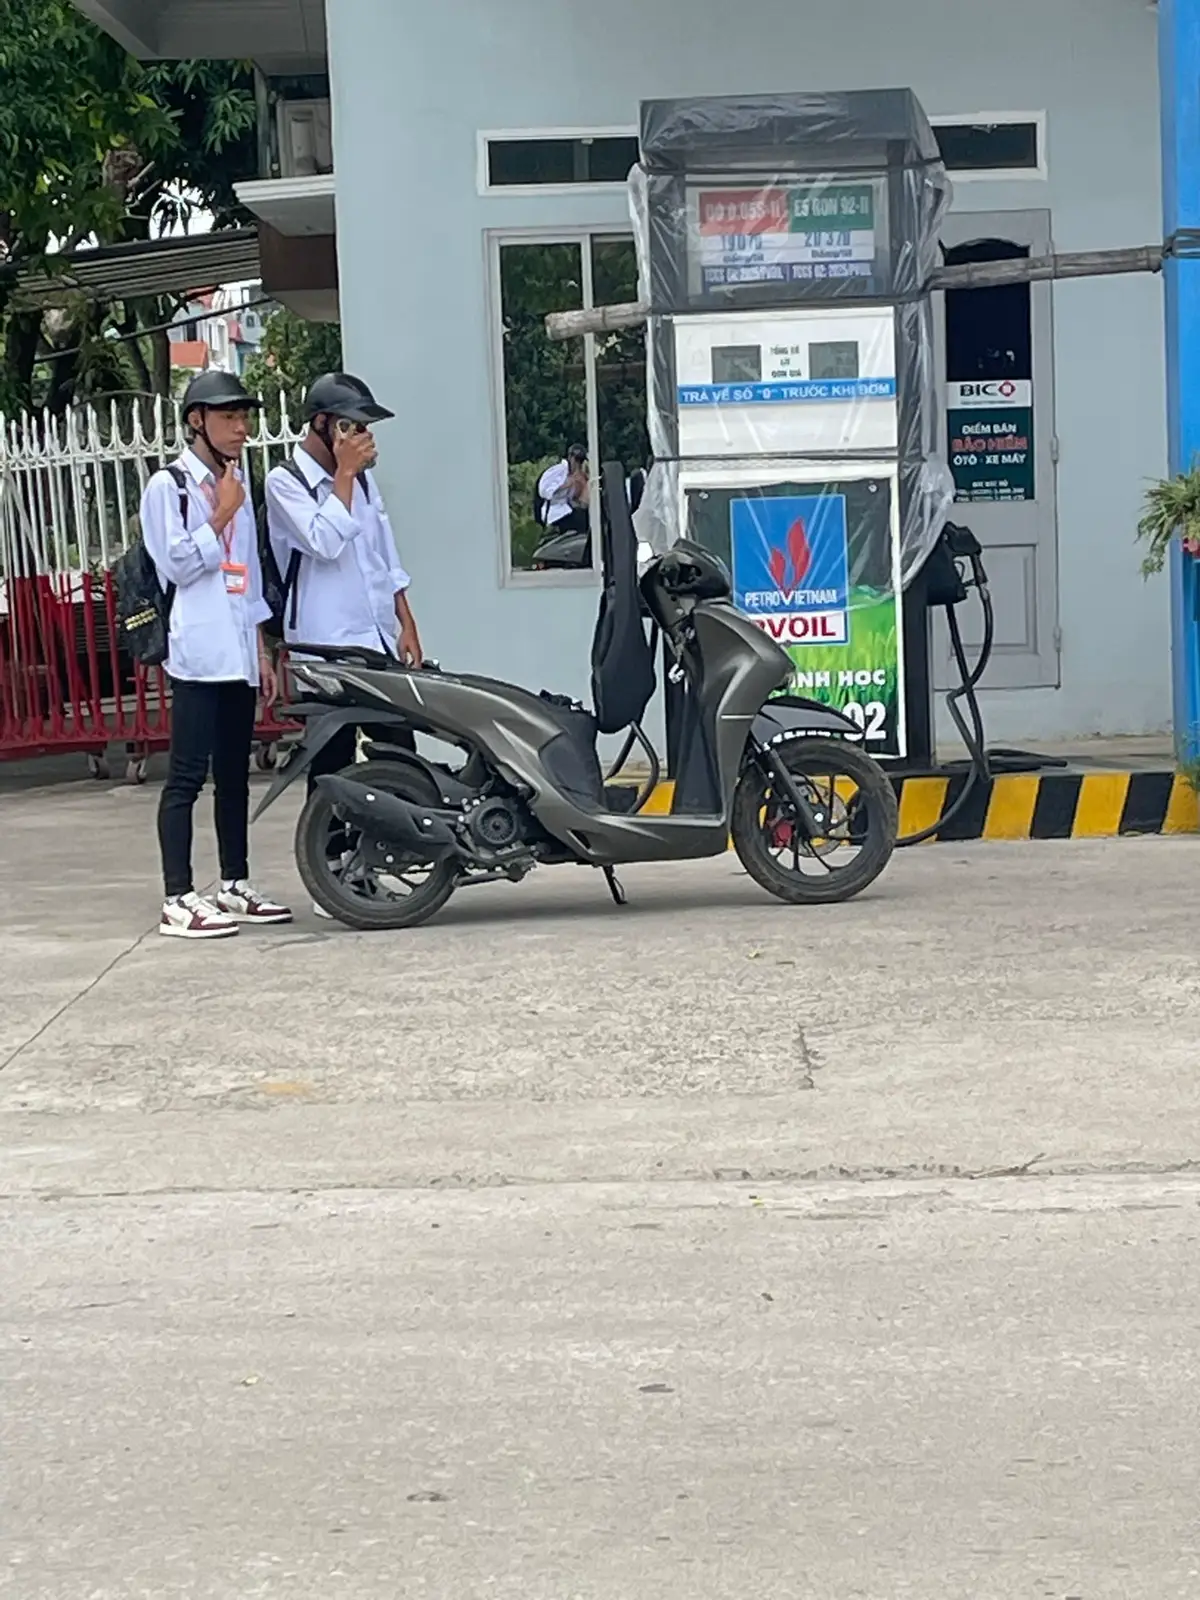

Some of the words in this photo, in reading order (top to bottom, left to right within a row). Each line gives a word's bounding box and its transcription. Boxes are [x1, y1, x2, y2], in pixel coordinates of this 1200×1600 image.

[812, 197, 837, 217] RON
[682, 387, 709, 402] TRẢ
[733, 385, 754, 401] SỐ
[832, 385, 856, 396] KHI
[985, 454, 999, 465] XE
[745, 589, 838, 607] PETROVIETNAM
[788, 671, 830, 688] INH
